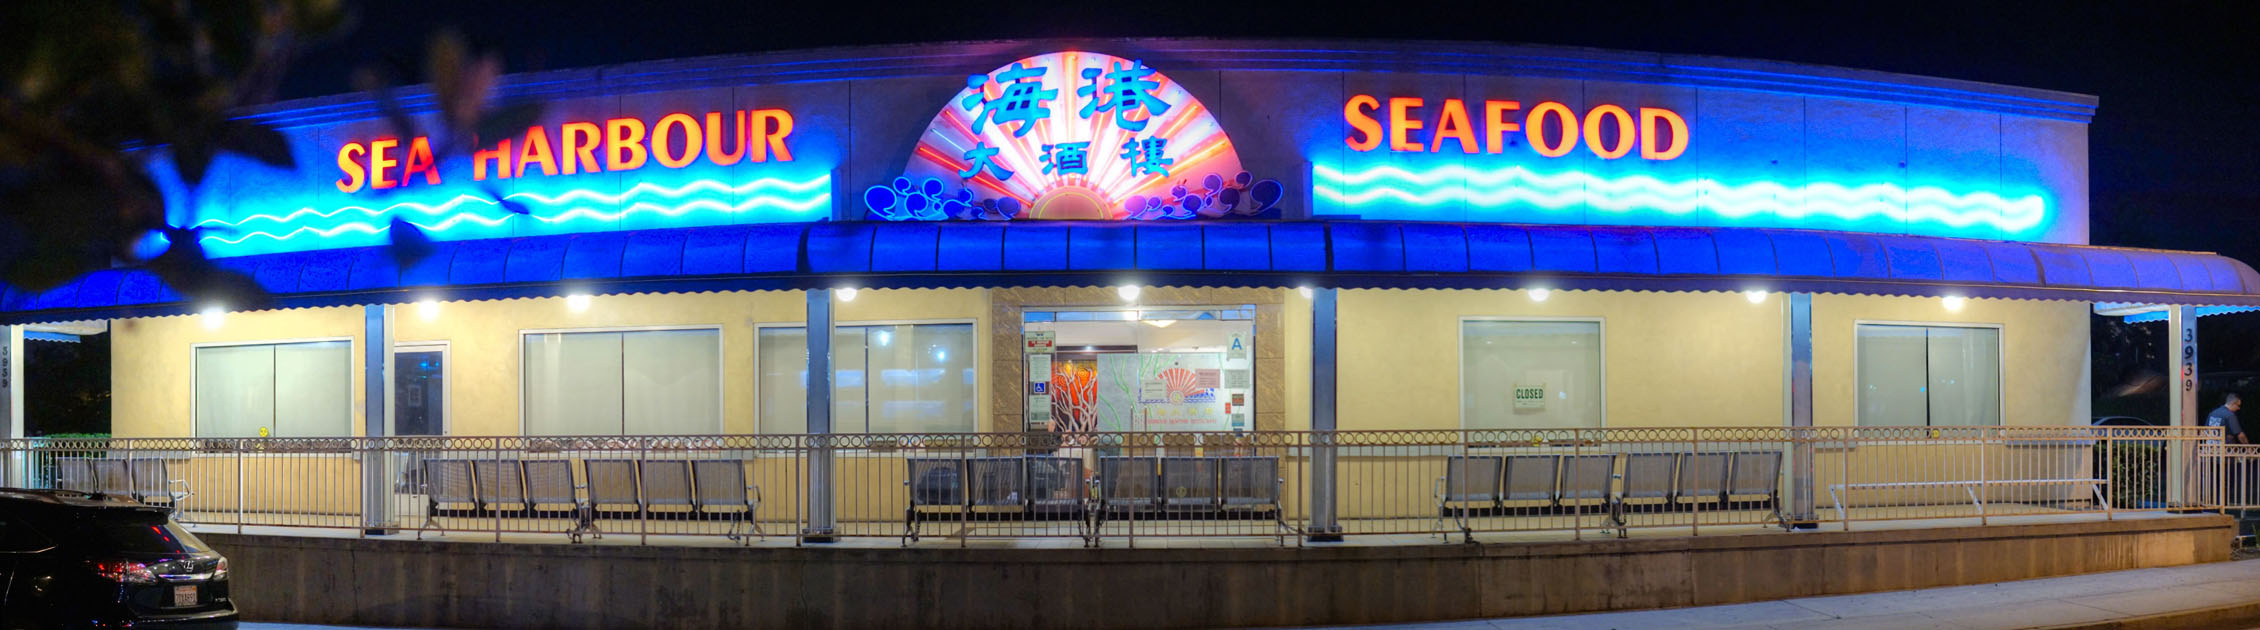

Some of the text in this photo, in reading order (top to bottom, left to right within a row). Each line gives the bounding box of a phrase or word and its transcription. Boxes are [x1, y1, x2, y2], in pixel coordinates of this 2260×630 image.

[961, 59, 1172, 138] 海港
[1343, 94, 1690, 161] SEAFOOD
[335, 136, 442, 193] SEA
[957, 136, 1175, 181] 大酒樓
[1231, 337, 1243, 351] A
[2184, 328, 2194, 392] 3939
[1515, 388, 1544, 399] CLOSED
